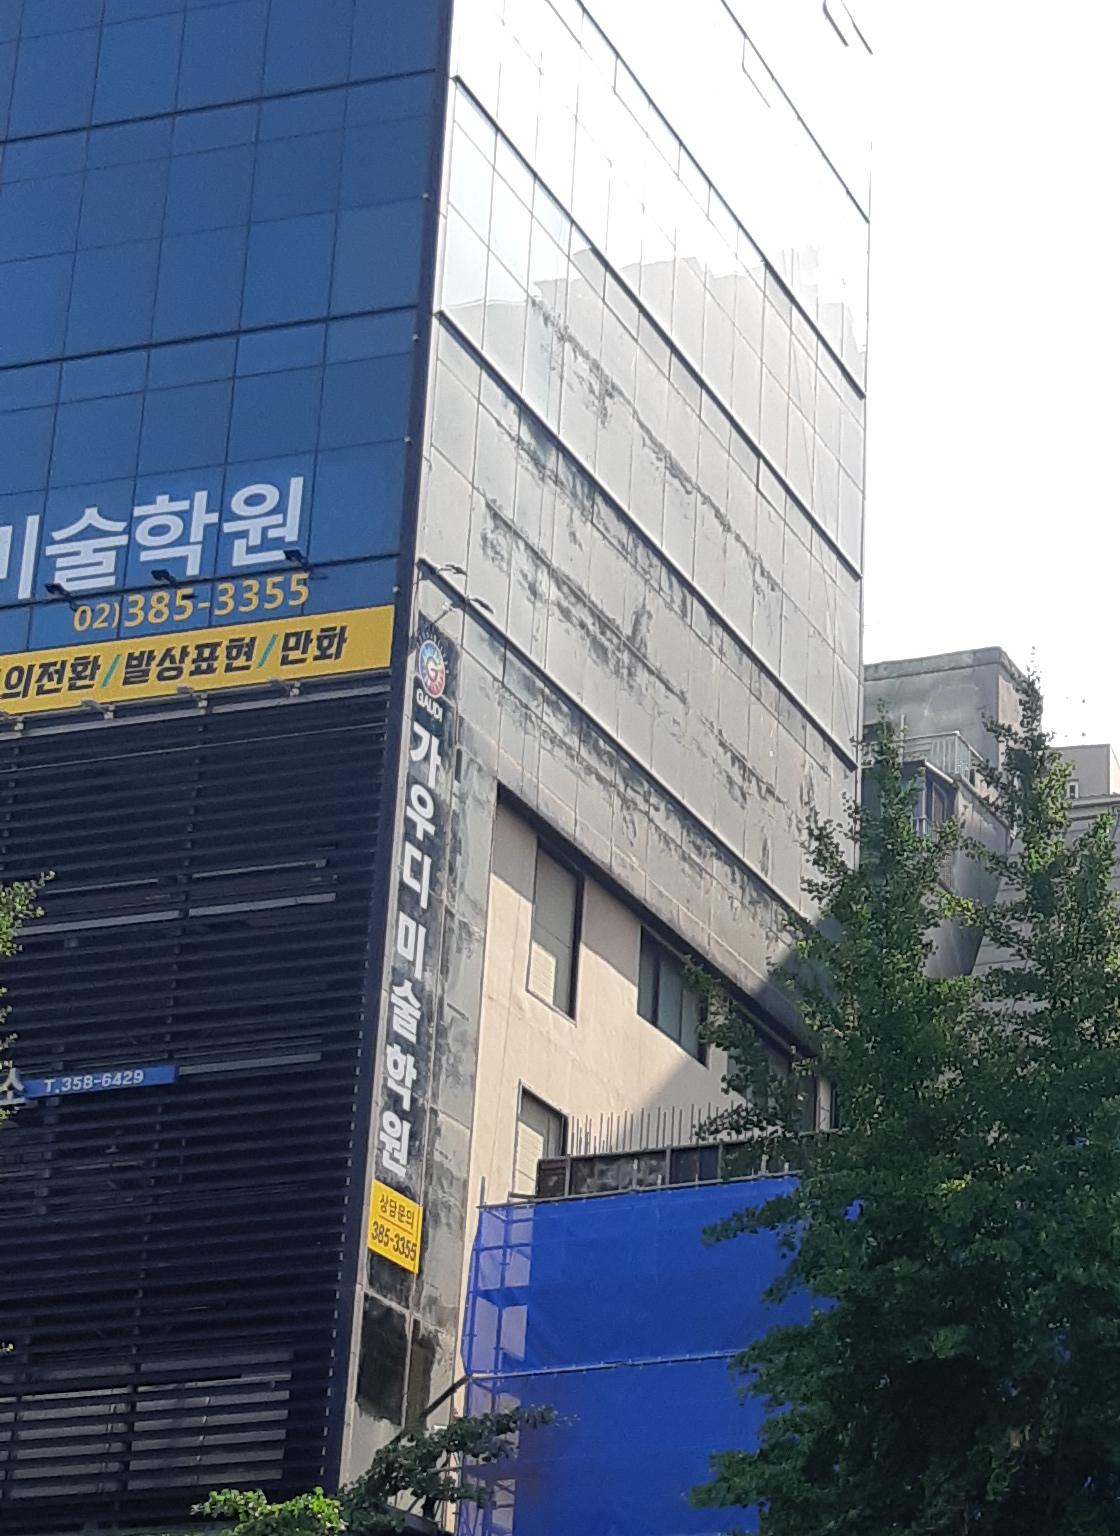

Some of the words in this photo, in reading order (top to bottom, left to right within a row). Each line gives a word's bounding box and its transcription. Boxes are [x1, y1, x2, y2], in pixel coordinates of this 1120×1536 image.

[416, 688, 444, 722] GAUDI
[44, 1069, 144, 1094] T.358-6429
[371, 1220, 418, 1262] 385-3355
